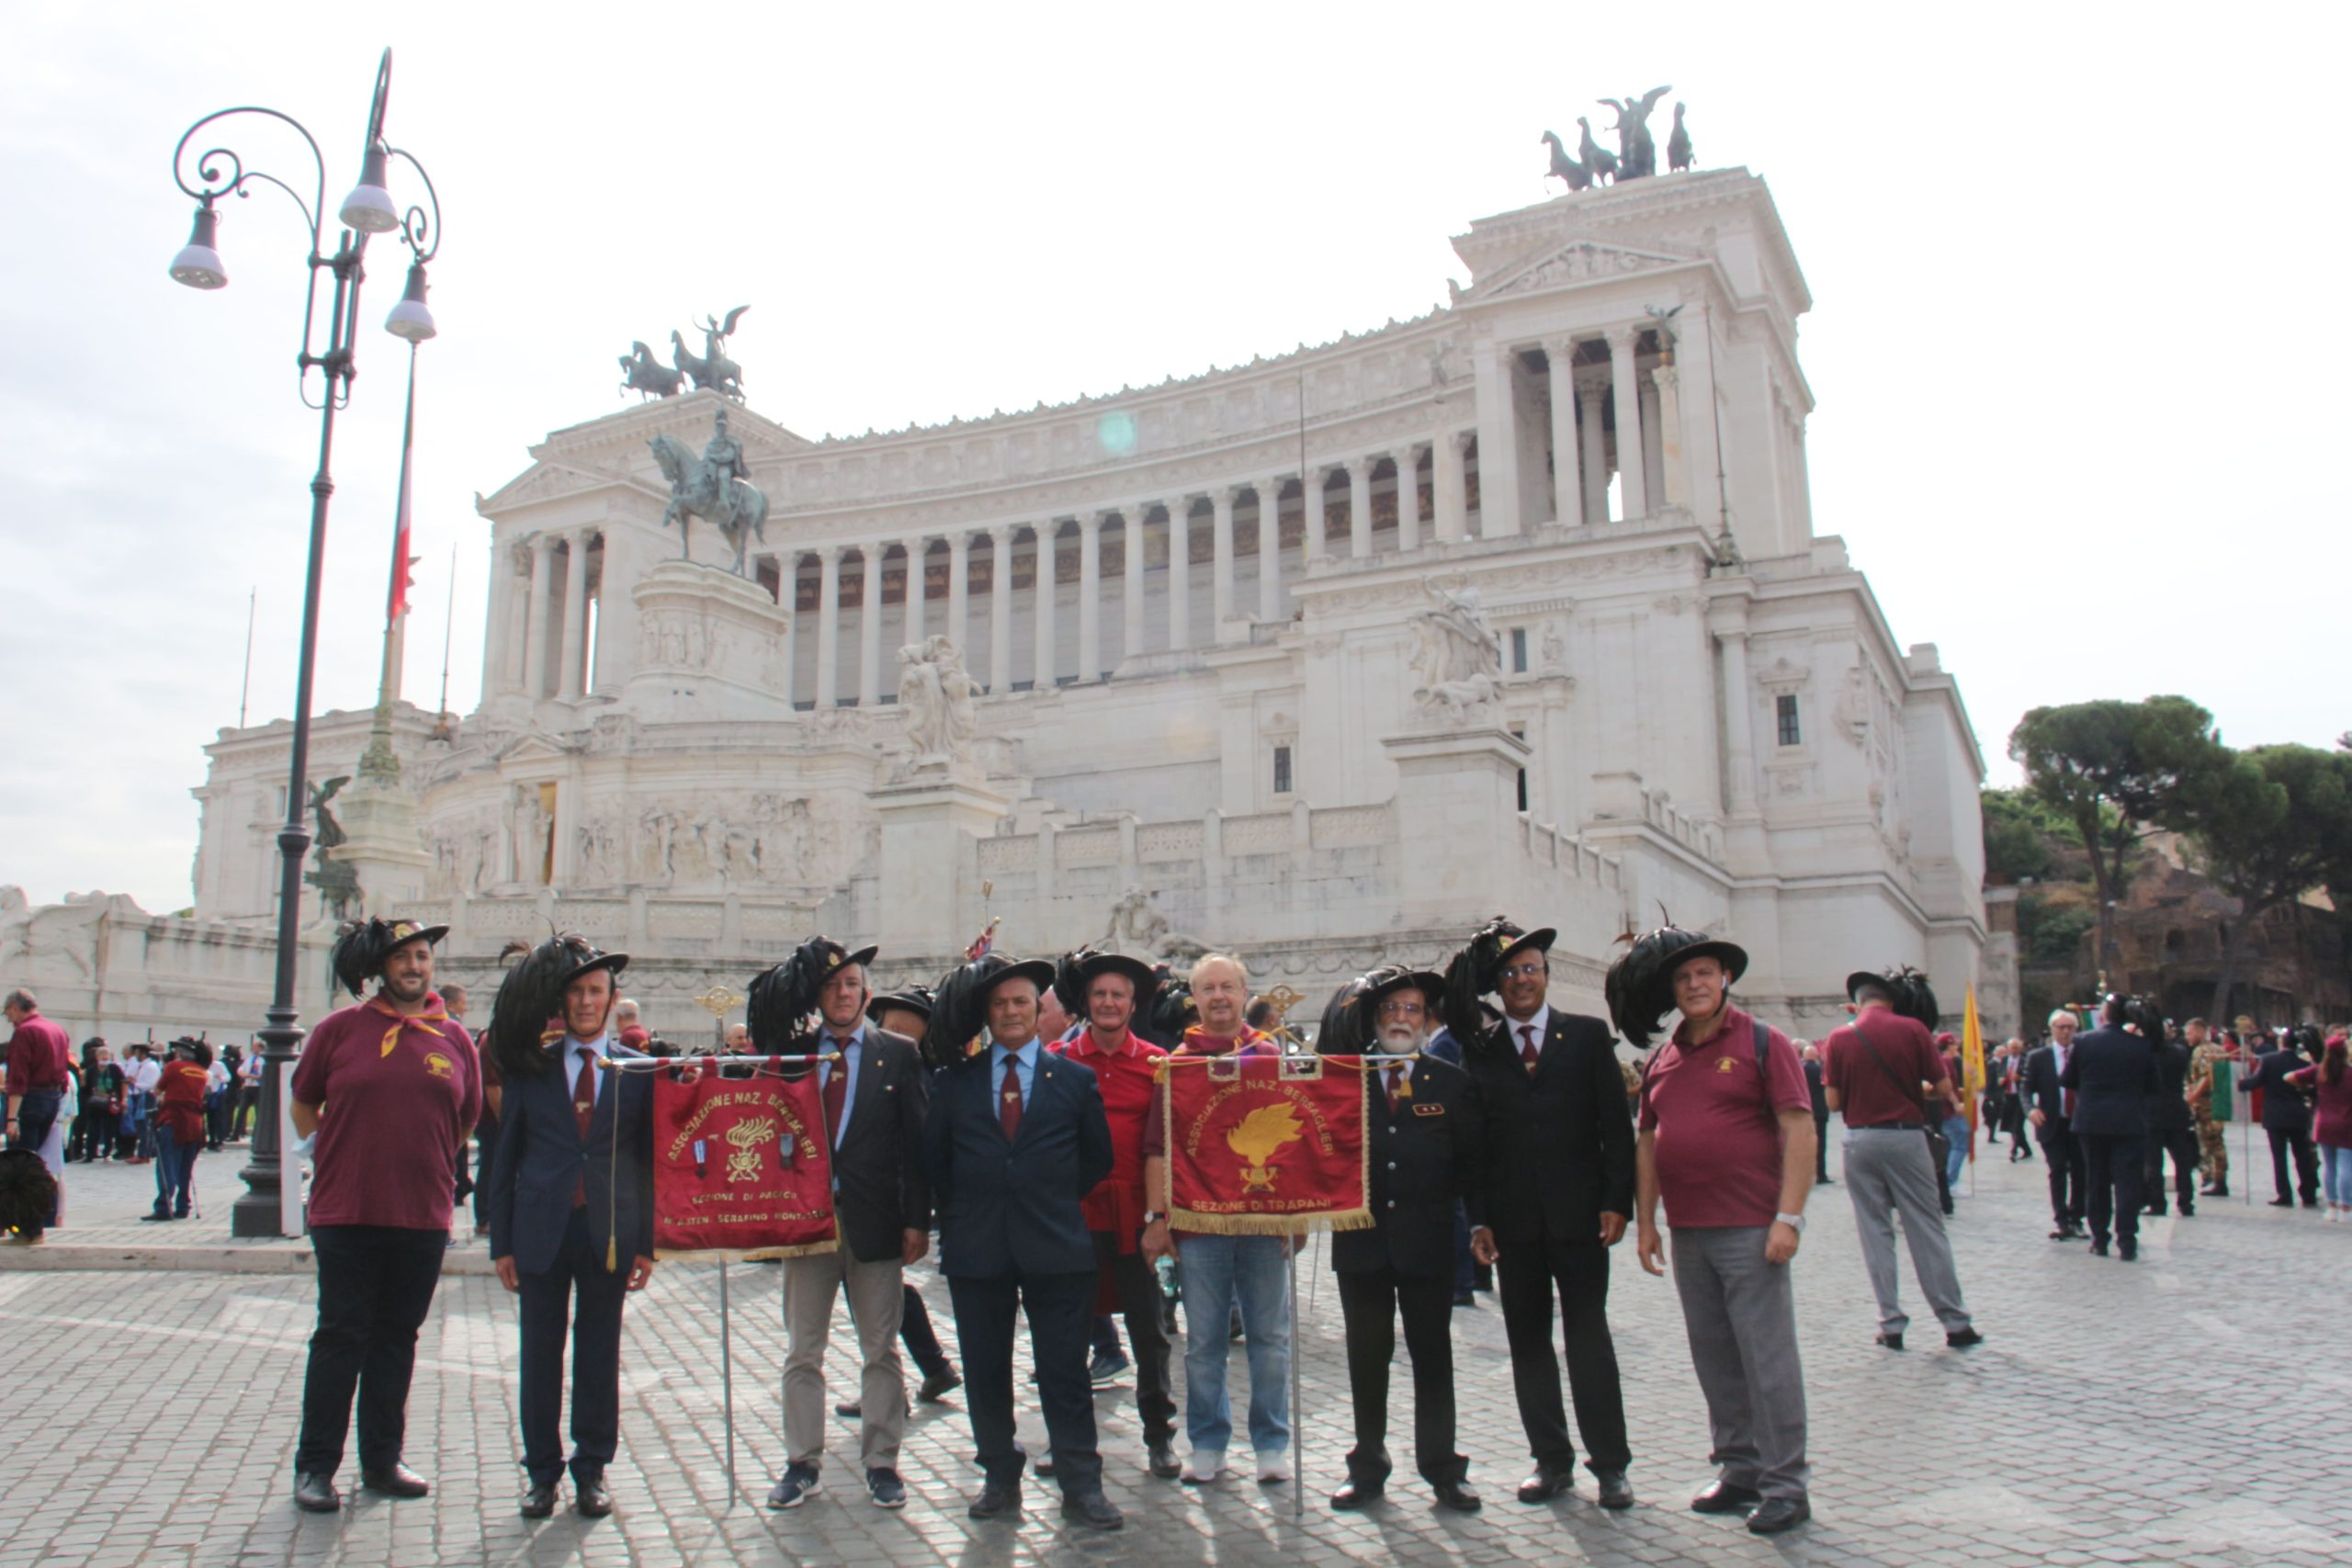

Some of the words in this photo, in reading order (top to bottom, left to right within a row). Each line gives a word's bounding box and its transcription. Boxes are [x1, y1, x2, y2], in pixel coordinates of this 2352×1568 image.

[1187, 1081, 1242, 1157] ASSOCIAZIONE
[1247, 1079, 1281, 1092] NAZ.
[1283, 1085, 1333, 1156] BERSAGLIERI
[668, 1093, 730, 1161] ASSOCIAZIONE
[735, 1092, 762, 1105] NAZ.
[766, 1093, 818, 1159] BERSAGIERI
[742, 1193, 753, 1201] DI
[1192, 1200, 1246, 1213] SEZIONE
[1251, 1201, 1263, 1212] DI
[1269, 1198, 1330, 1212] TRAPANI
[718, 1213, 768, 1224] SERAFINO
